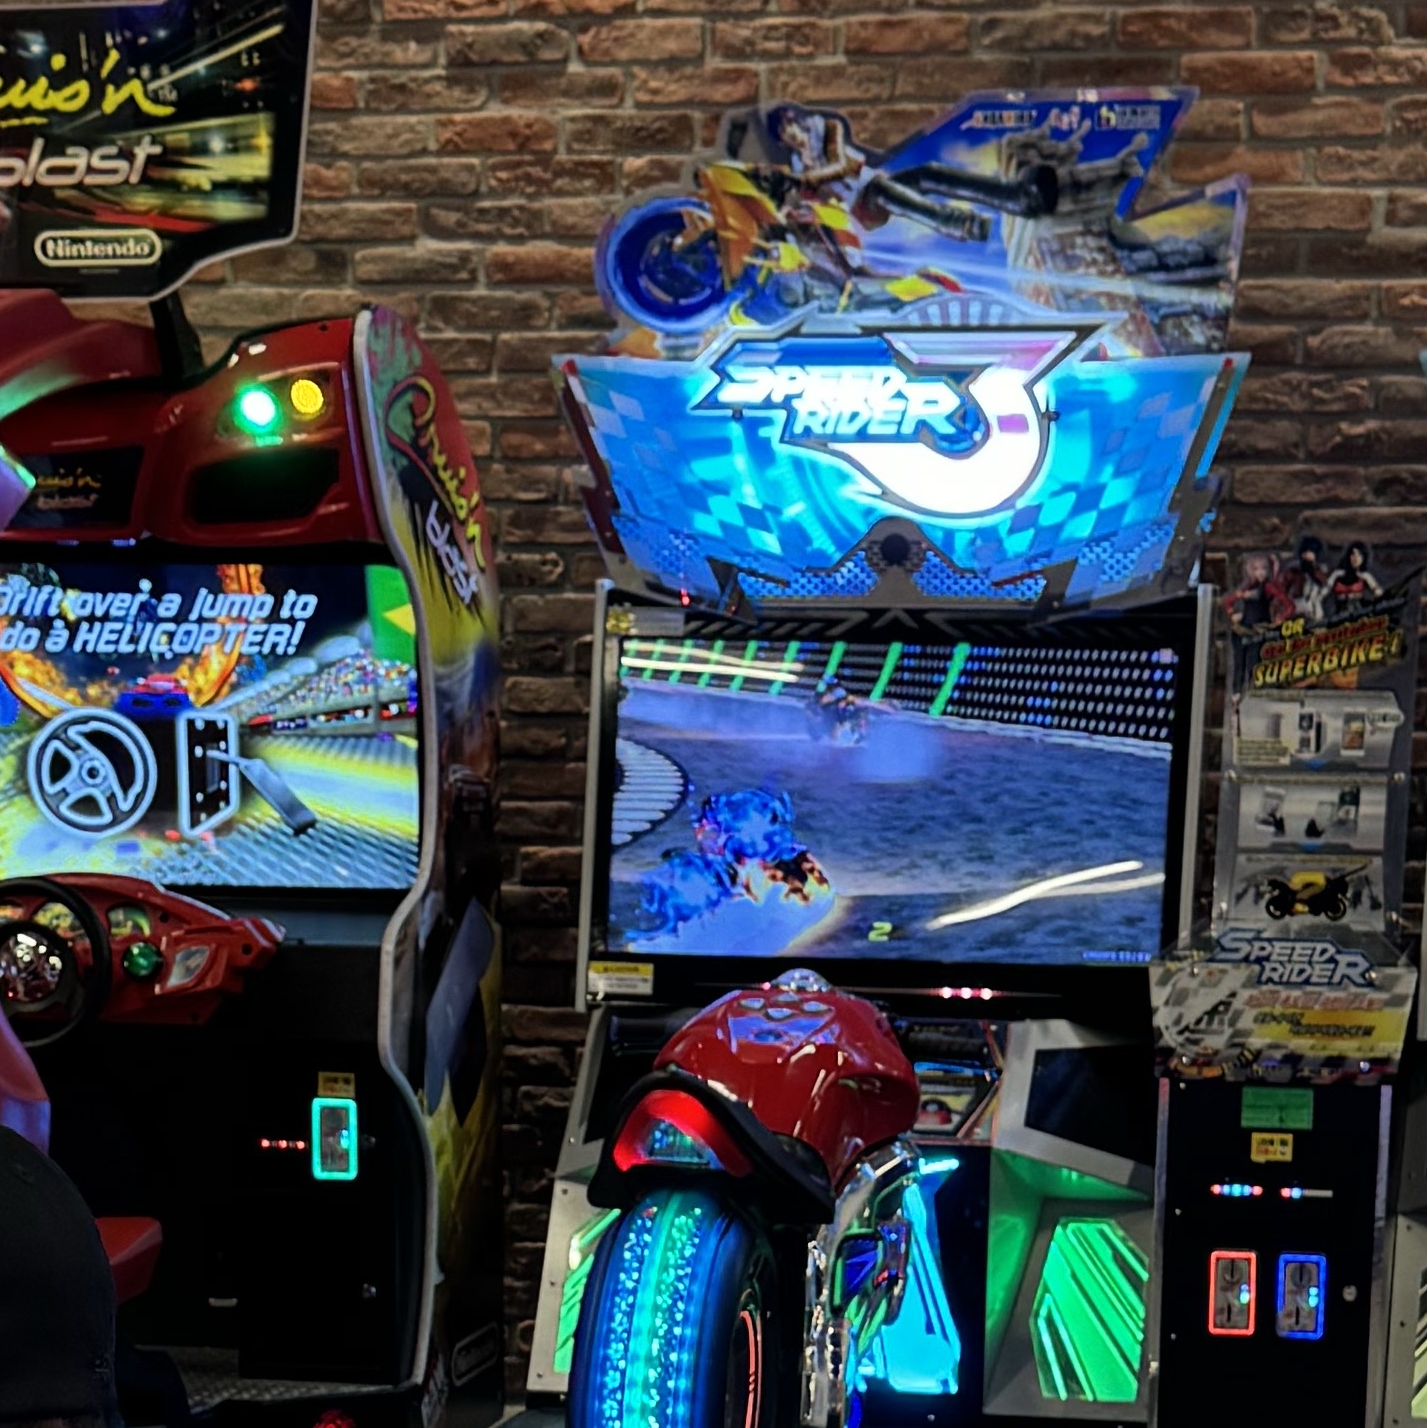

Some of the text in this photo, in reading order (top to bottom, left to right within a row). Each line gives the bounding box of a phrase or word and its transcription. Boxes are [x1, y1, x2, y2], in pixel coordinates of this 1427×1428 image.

[46, 236, 150, 259] Nintendo
[718, 366, 908, 403] SPEED
[793, 382, 961, 435] RIDER
[73, 592, 148, 617] over
[157, 594, 181, 618] a
[189, 587, 274, 621] jump
[280, 589, 317, 619] to
[45, 624, 69, 652] a
[73, 621, 306, 655] HELICOPTER!
[868, 922, 892, 941] 2
[1216, 929, 1334, 963] SPEED
[1259, 952, 1372, 986] RIDER
